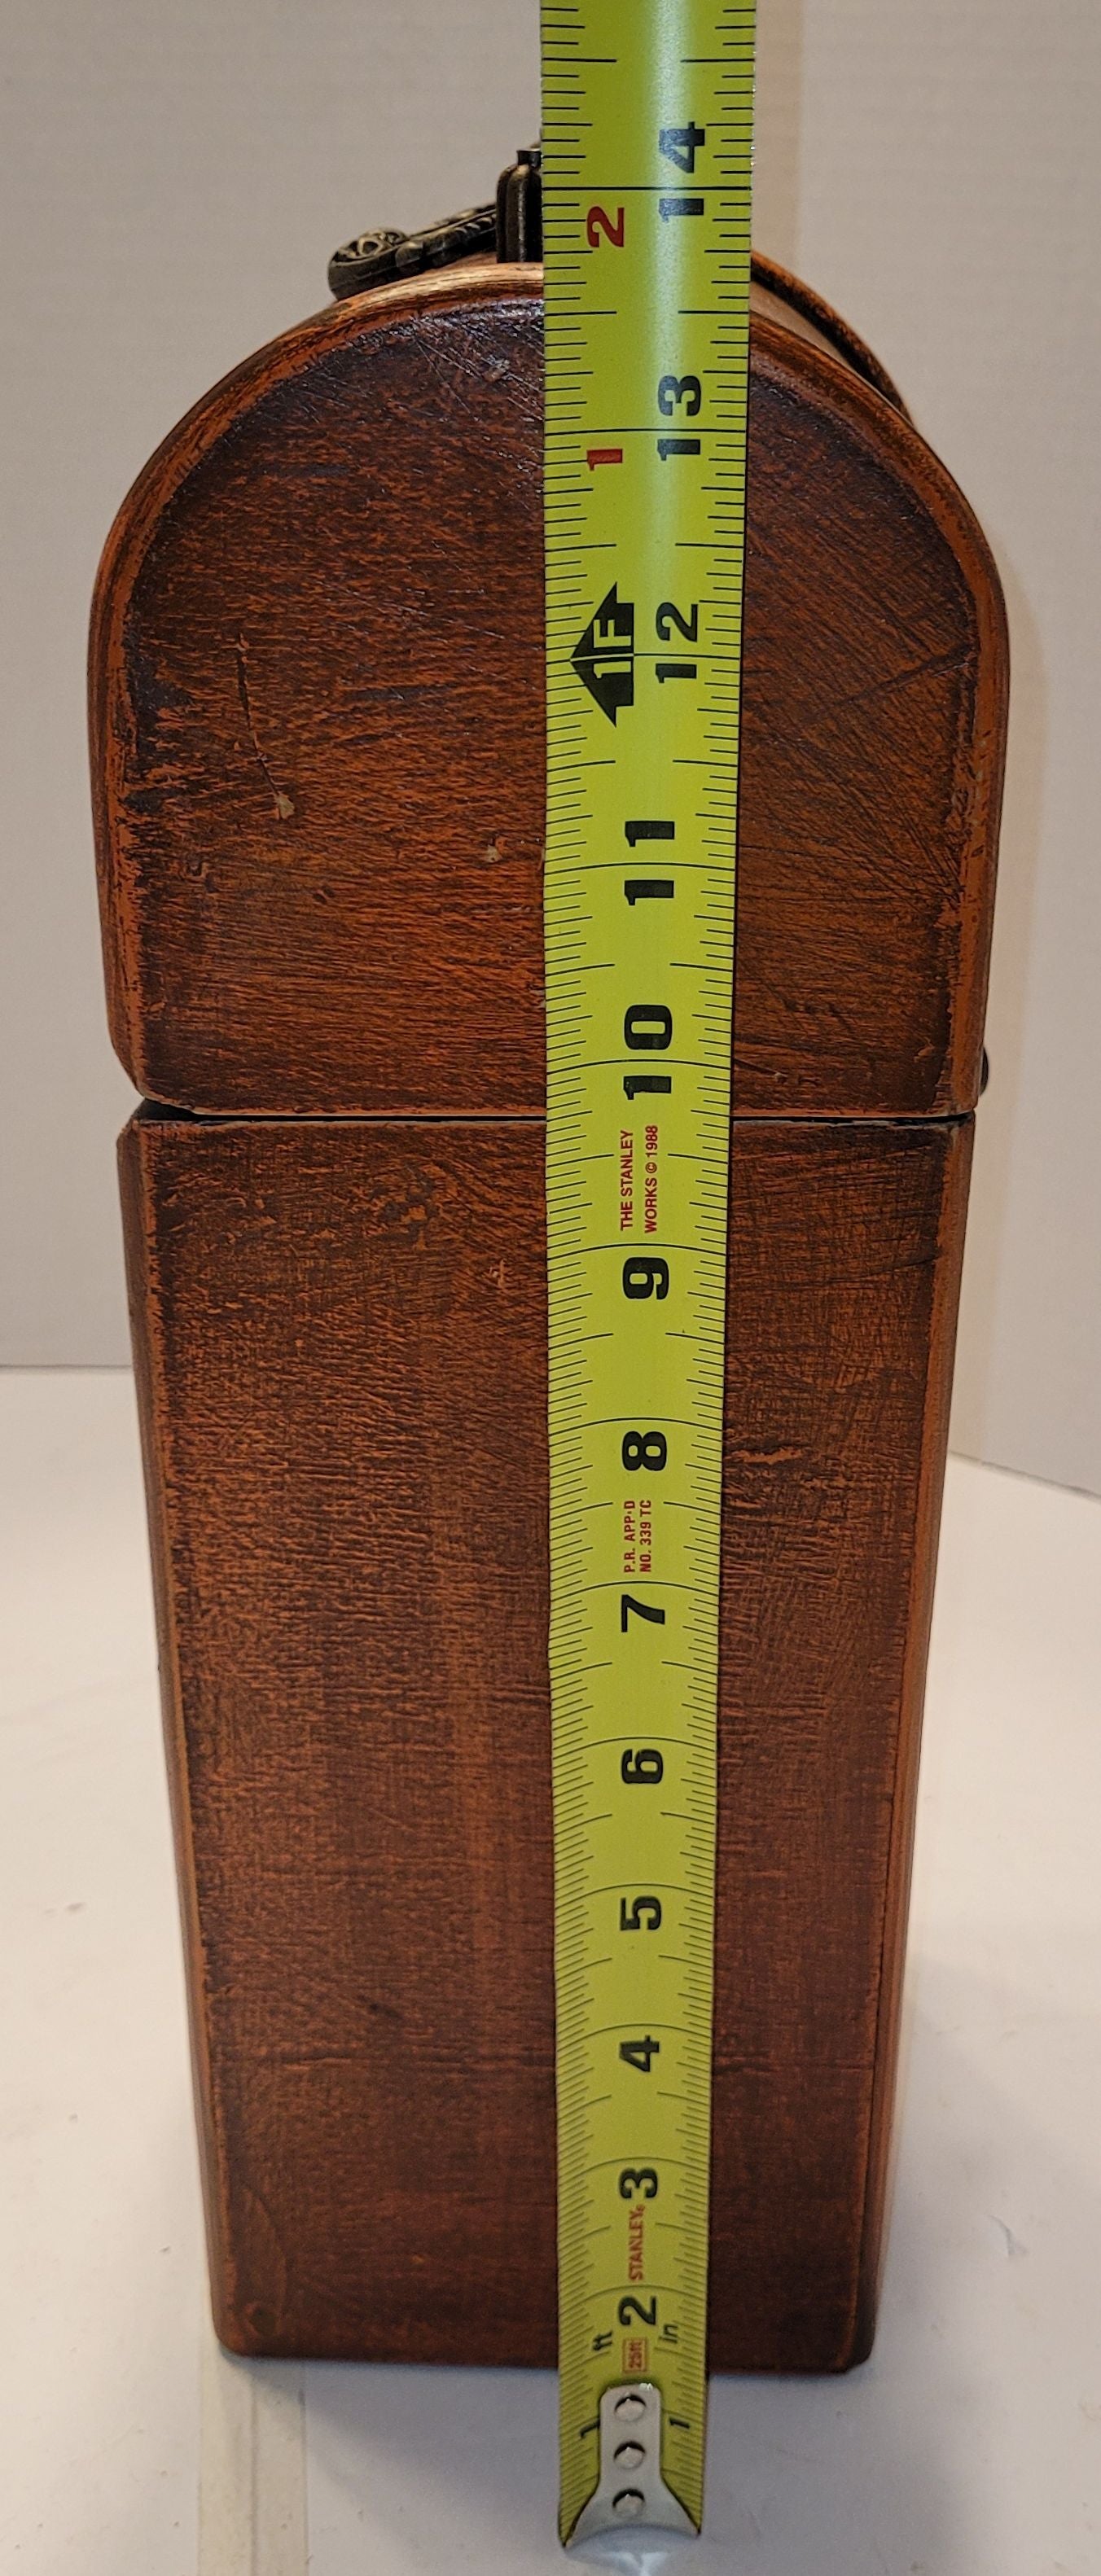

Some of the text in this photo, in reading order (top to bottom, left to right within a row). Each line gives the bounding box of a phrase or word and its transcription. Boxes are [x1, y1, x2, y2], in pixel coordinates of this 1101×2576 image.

[659, 121, 705, 222] 14
[586, 206, 625, 248] 2
[657, 375, 701, 461] 13
[586, 449, 623, 471] 1
[655, 602, 698, 683] 12
[625, 821, 675, 905] 11
[623, 1005, 673, 1100] 10
[645, 1125, 658, 1158] 1988
[620, 1130, 633, 1231] THE STANLEY
[645, 1177, 657, 1233] WORKS
[622, 1257, 669, 1300] 9
[621, 1430, 667, 1471] 8
[639, 1500, 651, 1572] NO. 339 TC
[624, 1548, 635, 1573] P.R.
[621, 1594, 665, 1632] 7
[621, 1749, 664, 1784] 6
[620, 1895, 661, 1931] 5
[619, 2035, 660, 2072] 4
[619, 2167, 658, 2198] 3
[618, 2295, 657, 2326] 2
[669, 2417, 691, 2429] 1
